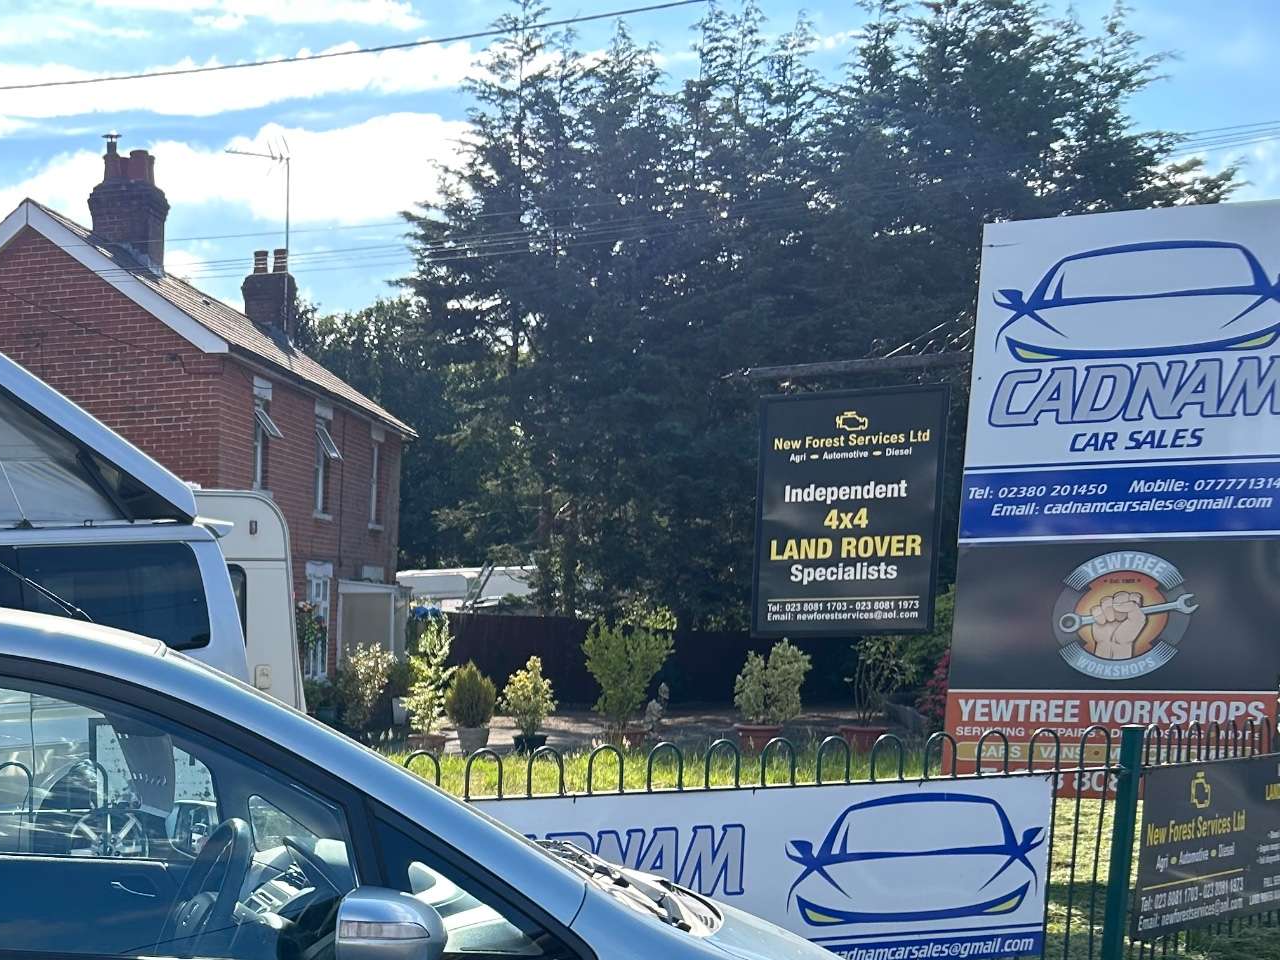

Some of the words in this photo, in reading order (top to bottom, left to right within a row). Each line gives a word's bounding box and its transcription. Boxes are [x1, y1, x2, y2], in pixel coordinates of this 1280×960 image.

[988, 356, 1280, 428] CADNAM
[774, 438, 801, 450] New
[805, 435, 845, 448] Forest
[848, 432, 905, 446] Services
[910, 429, 930, 443] Ltd
[1069, 431, 1118, 453] CAR
[1124, 428, 1206, 450] SALES
[789, 452, 807, 463] Agri
[822, 450, 869, 460] Automotive
[885, 447, 912, 457] Diesel
[784, 480, 908, 504] Independent
[968, 486, 994, 500] Tel:
[998, 485, 1046, 498] 02380
[1050, 483, 1108, 496] 201450
[1128, 479, 1190, 494] Mobile:
[991, 502, 1040, 517] Email:
[1043, 496, 1273, 515] cadnamcarsales@gmail.com
[824, 508, 869, 530] 4x4
[770, 537, 833, 561] LAND
[841, 534, 922, 558] ROVER
[790, 562, 898, 585] Specialists
[1082, 553, 1168, 578] YEWTREE
[767, 603, 782, 612] Tel:
[785, 603, 801, 611] 023
[826, 602, 848, 611] 1703
[855, 601, 871, 610] 023
[898, 600, 920, 609] 1973
[767, 612, 793, 621] Email:
[1076, 656, 1157, 678] WORKSHOPS
[958, 699, 1081, 723] YEWTREE
[1088, 700, 1265, 726] WORKSHOPS
[1146, 823, 1167, 847] New
[1168, 818, 1195, 843] Forest
[1197, 813, 1231, 837] Services
[1233, 809, 1246, 832] Ltd
